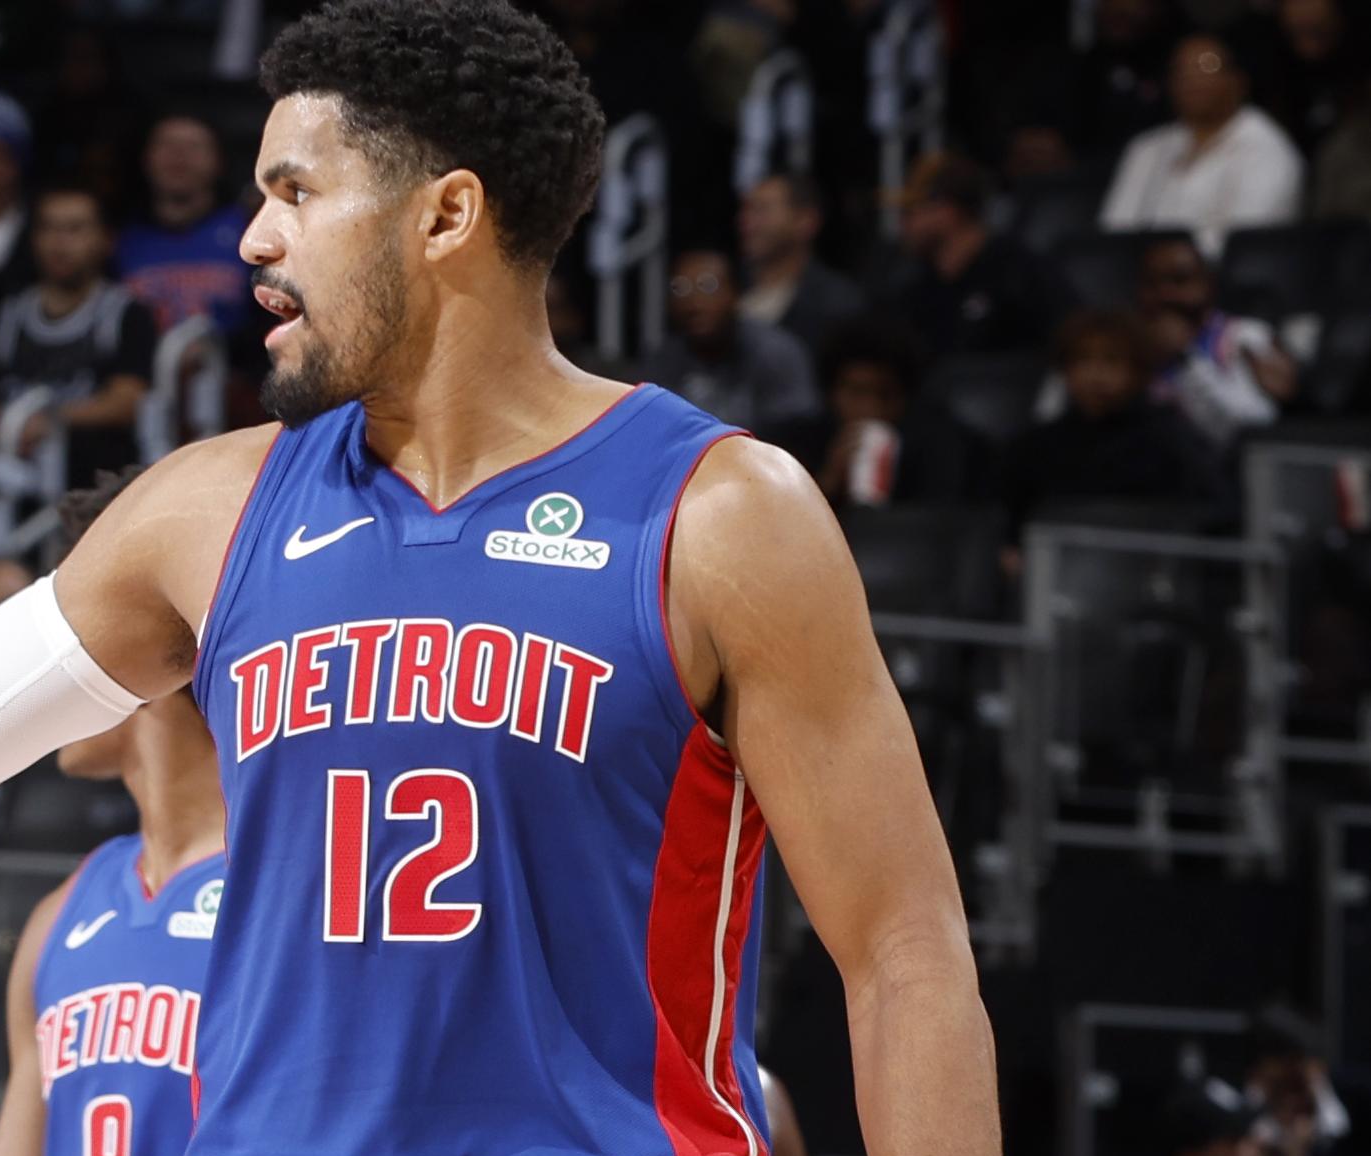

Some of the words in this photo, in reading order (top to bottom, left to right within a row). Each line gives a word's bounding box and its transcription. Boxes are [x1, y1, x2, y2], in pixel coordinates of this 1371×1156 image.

[490, 535, 605, 564] StockX
[230, 618, 614, 763] DETROIT
[324, 768, 482, 942] 12
[36, 982, 201, 1100] DETROI
